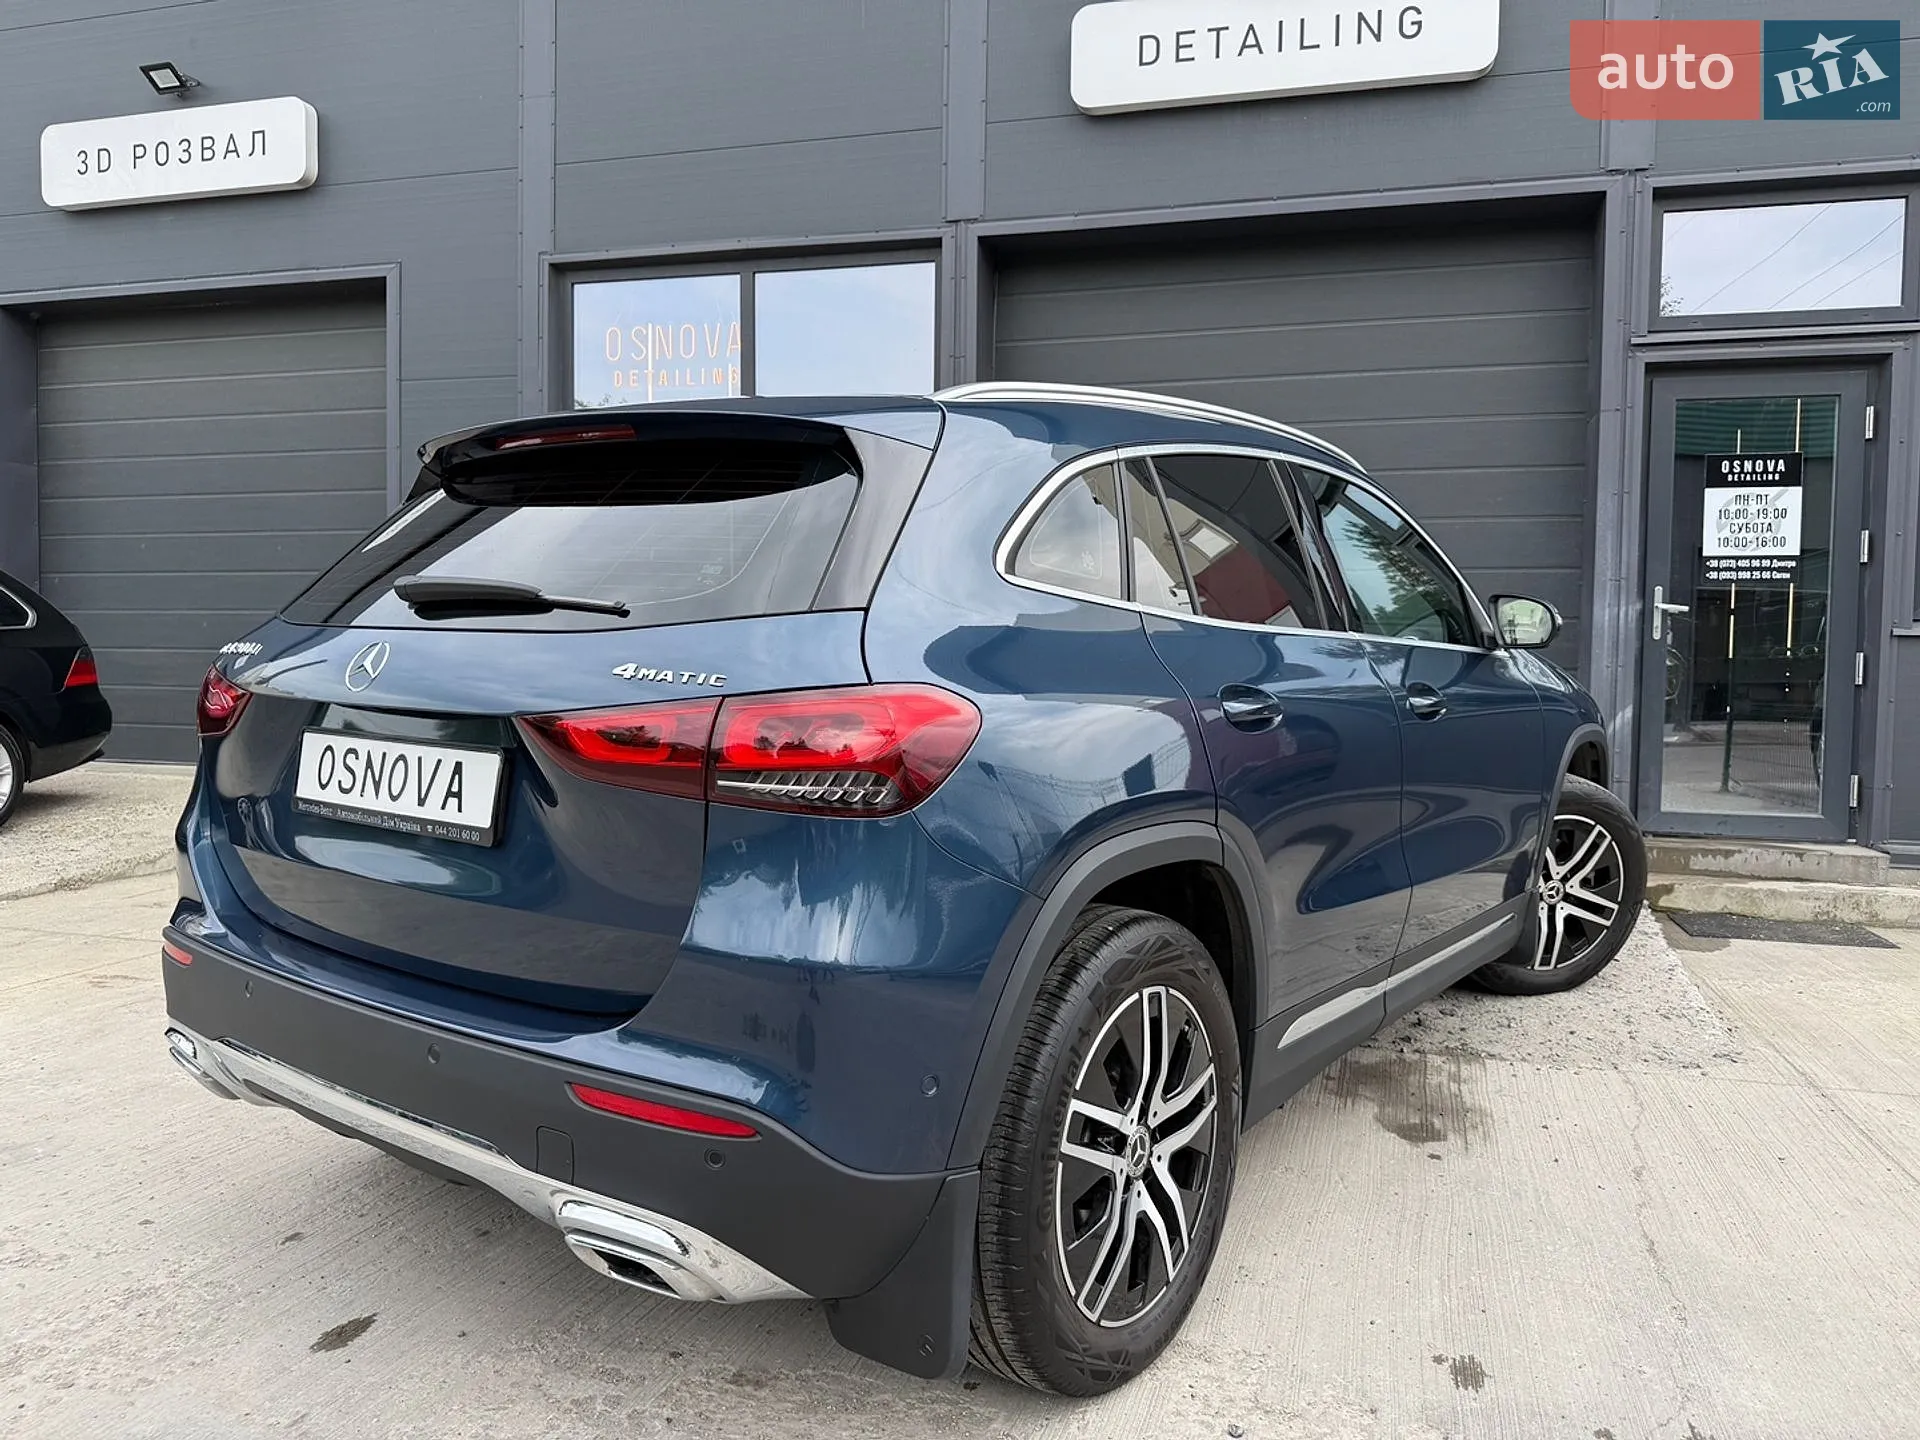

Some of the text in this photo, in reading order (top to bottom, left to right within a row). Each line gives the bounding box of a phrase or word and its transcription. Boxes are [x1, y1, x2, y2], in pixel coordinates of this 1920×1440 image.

[1138, 5, 1423, 67] DETAILING
[77, 129, 266, 176] 3D РОЗВАЛ
[606, 321, 741, 361] OSNOVA
[1721, 459, 1785, 473] OSNOVA
[1727, 473, 1780, 481] DETAILING
[1734, 494, 1769, 505] ПН-ПТ
[1730, 522, 1773, 534] СУБОТА
[1718, 536, 1787, 548] 10:00-16:00
[612, 662, 727, 687] 4MATIC
[317, 744, 463, 813] OSNOVA
[434, 825, 447, 835] 044
[448, 828, 460, 839] 201
